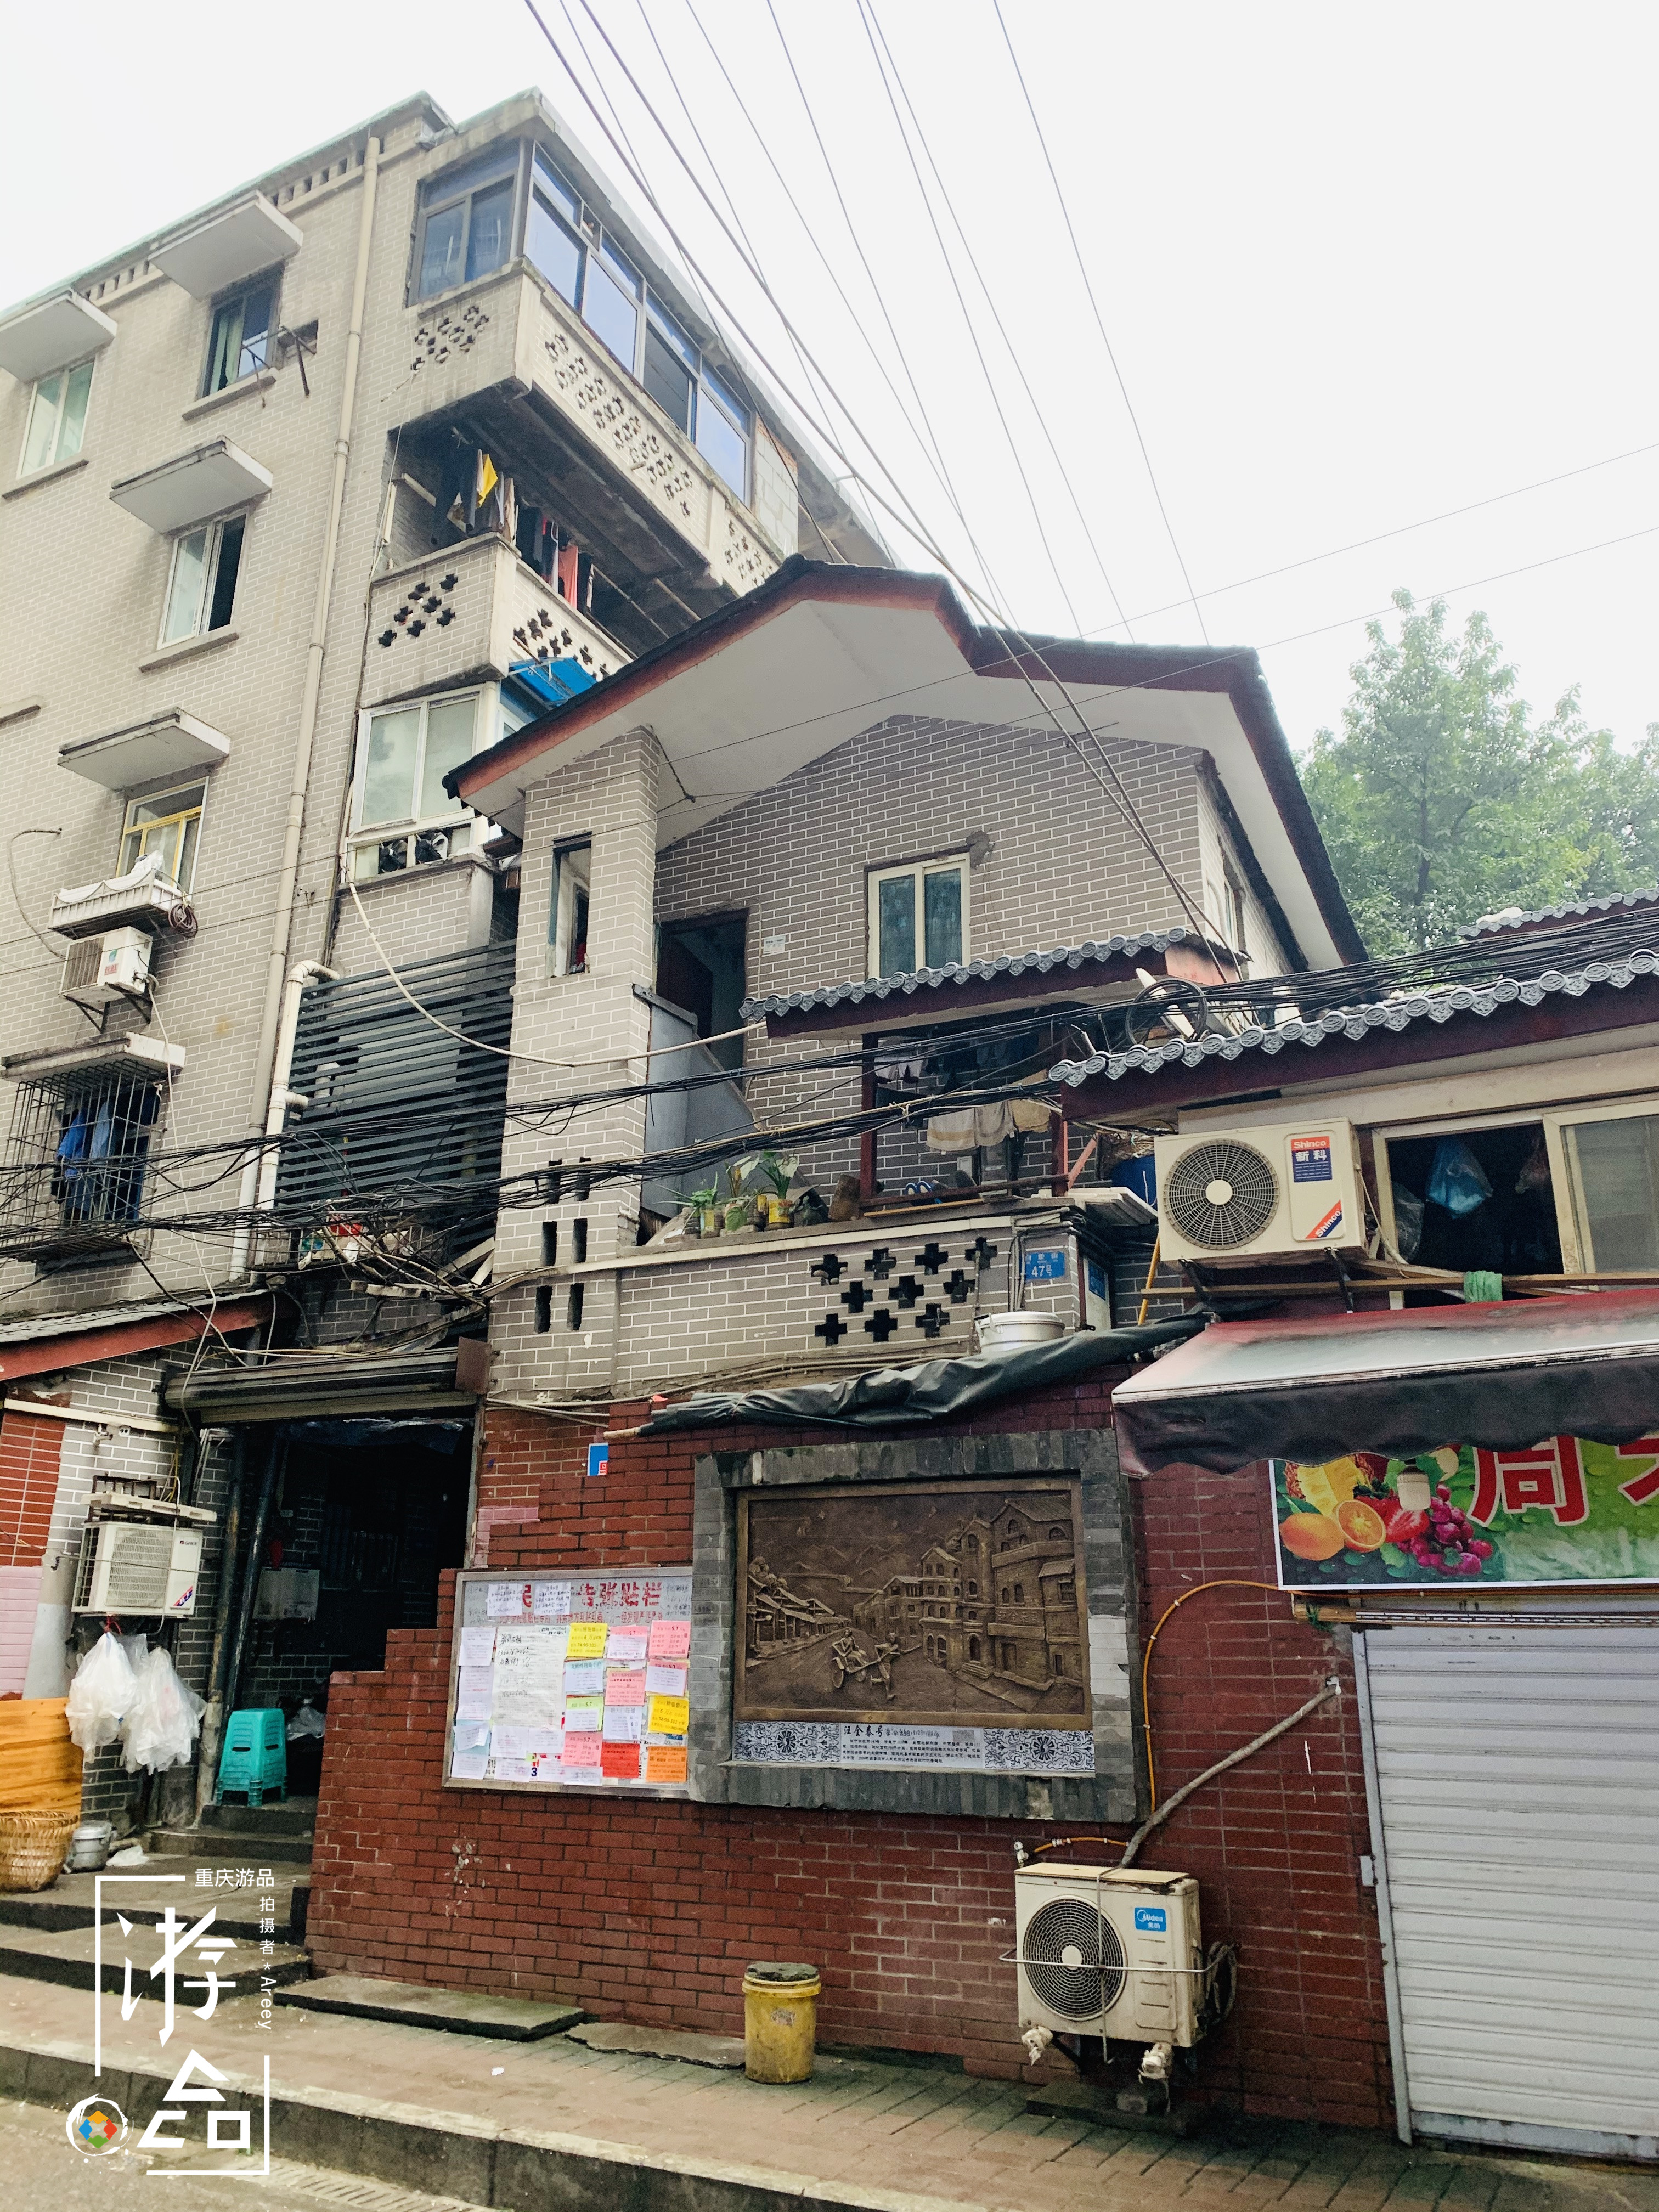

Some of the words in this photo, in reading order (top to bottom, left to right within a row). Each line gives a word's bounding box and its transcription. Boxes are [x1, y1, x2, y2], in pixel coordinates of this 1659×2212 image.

[1294, 1141, 1327, 1149] Shinco
[1295, 1149, 1327, 1162] 新科
[1315, 1210, 1341, 1237] Shinco
[1031, 1264, 1052, 1277] 47号
[1142, 1913, 1164, 1922] Midea
